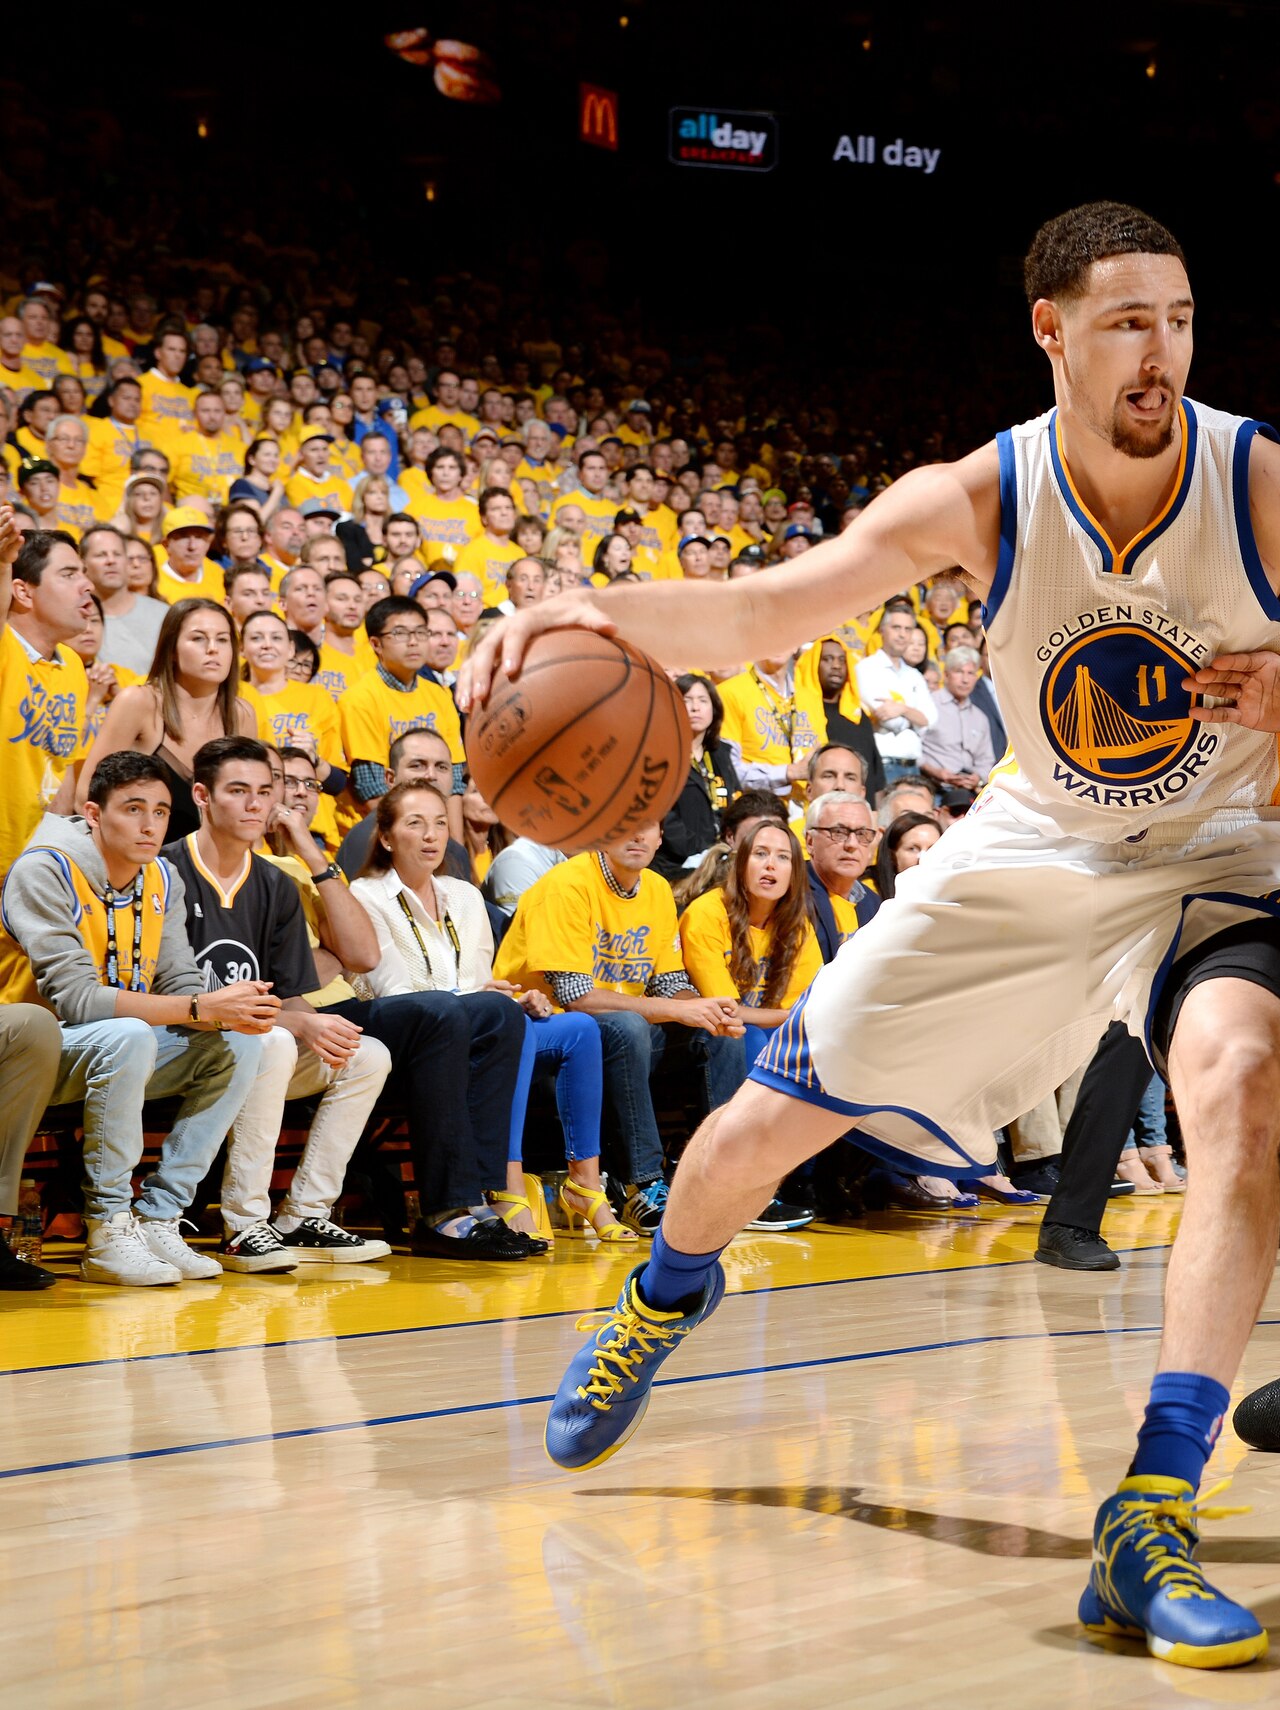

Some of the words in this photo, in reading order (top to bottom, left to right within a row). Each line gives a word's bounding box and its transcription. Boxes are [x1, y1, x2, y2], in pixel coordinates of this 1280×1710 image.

[679, 114, 717, 140] all
[711, 122, 767, 157] day
[832, 135, 875, 164] All
[882, 138, 941, 173] day
[1036, 604, 1133, 663] GOLDEN
[1141, 609, 1209, 661] STATE
[1134, 664, 1169, 707] 11
[1052, 731, 1219, 808] WARRIORS
[224, 960, 253, 985] 30
